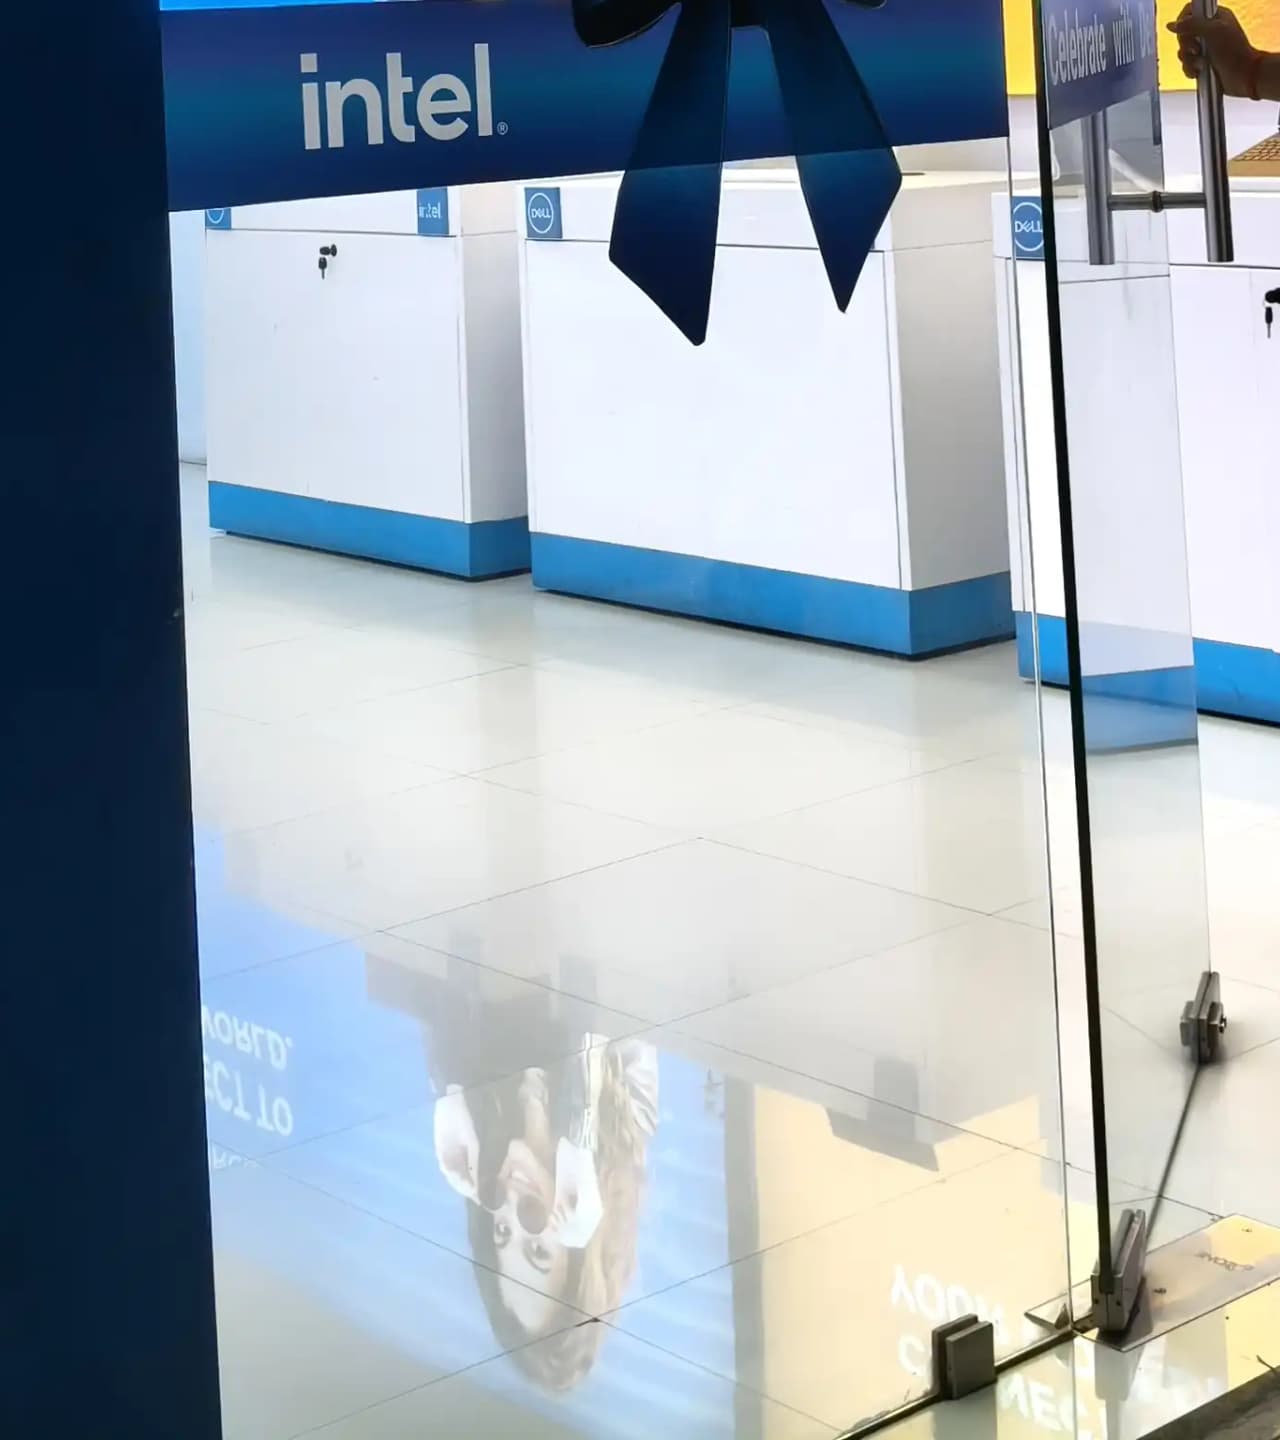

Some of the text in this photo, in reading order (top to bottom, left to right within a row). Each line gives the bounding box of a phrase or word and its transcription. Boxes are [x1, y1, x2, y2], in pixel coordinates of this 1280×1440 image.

[1048, 7, 1107, 86] Celebrate
[1113, 2, 1135, 68] with
[300, 43, 494, 150] intel
[1014, 219, 1043, 234] DELL
